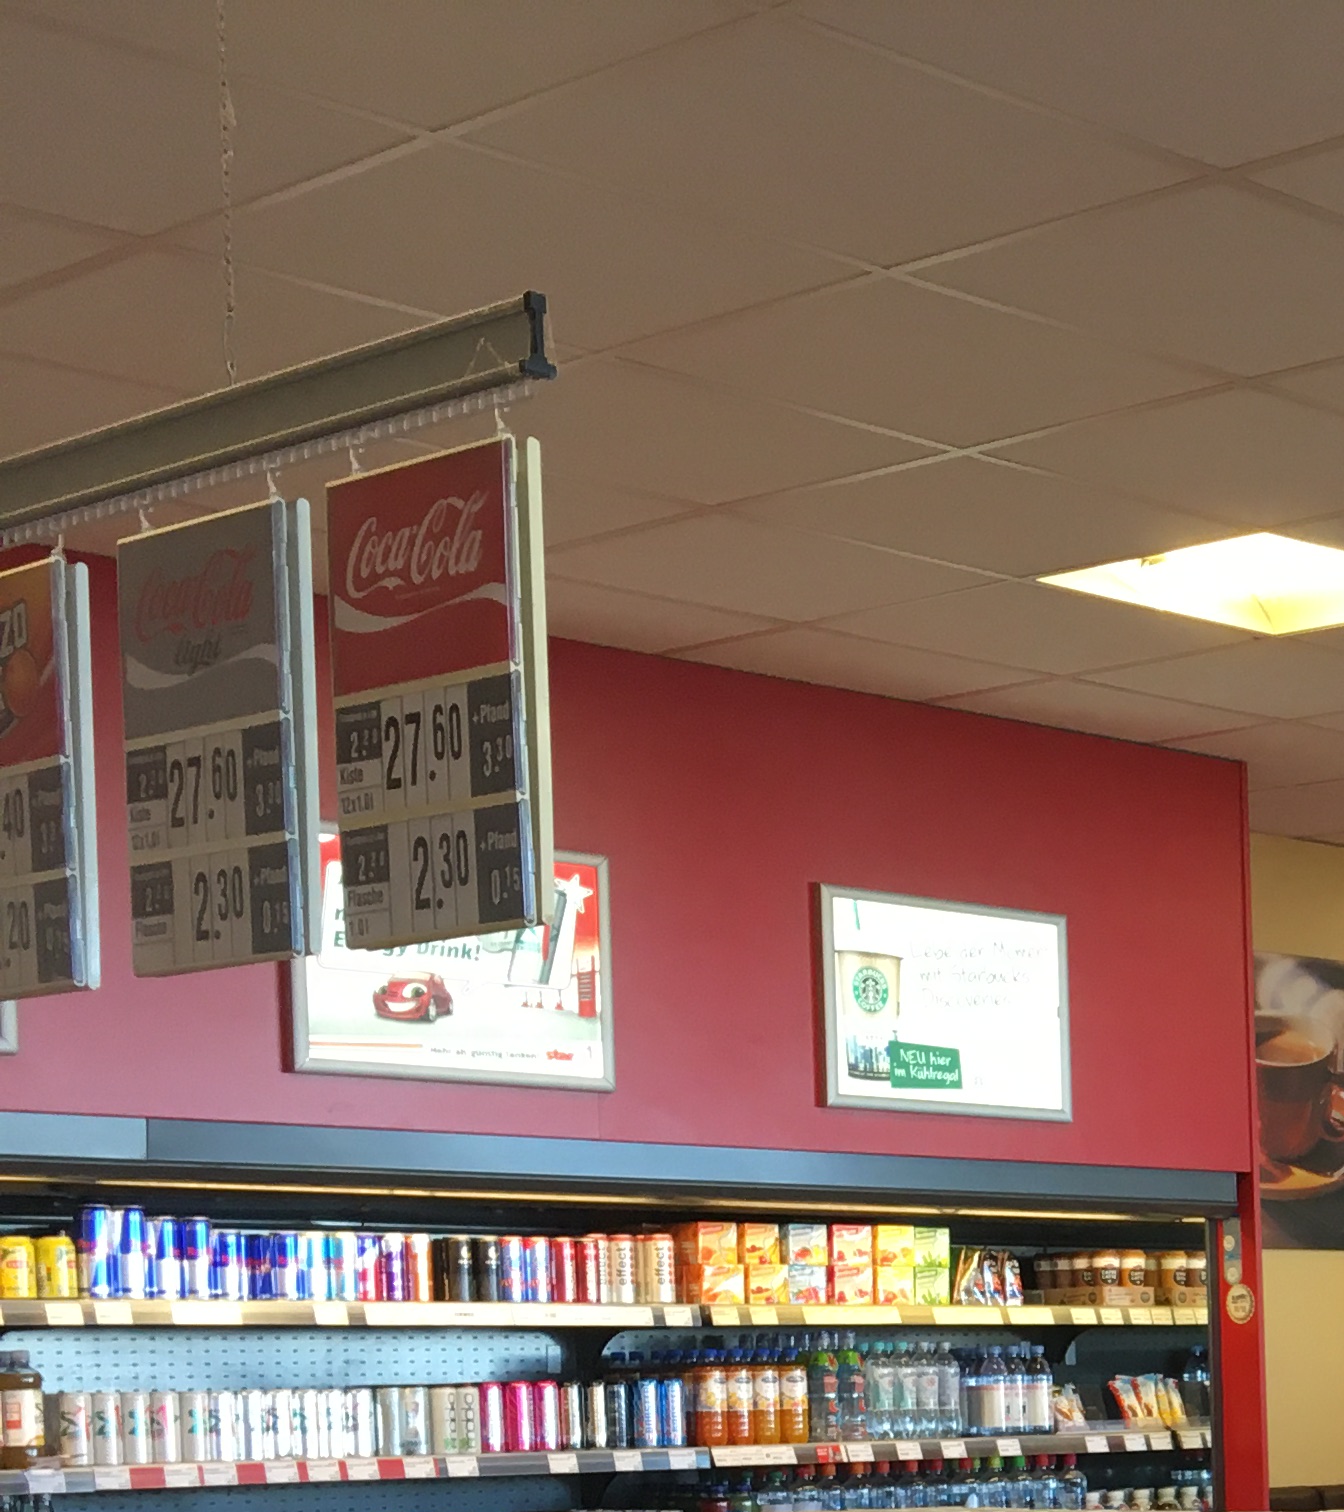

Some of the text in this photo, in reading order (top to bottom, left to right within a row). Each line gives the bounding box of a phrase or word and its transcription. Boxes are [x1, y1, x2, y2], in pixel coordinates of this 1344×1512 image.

[900, 1050, 951, 1067] NEU hier
[893, 1063, 960, 1086] im Kühlregal
[656, 1246, 665, 1287] effect
